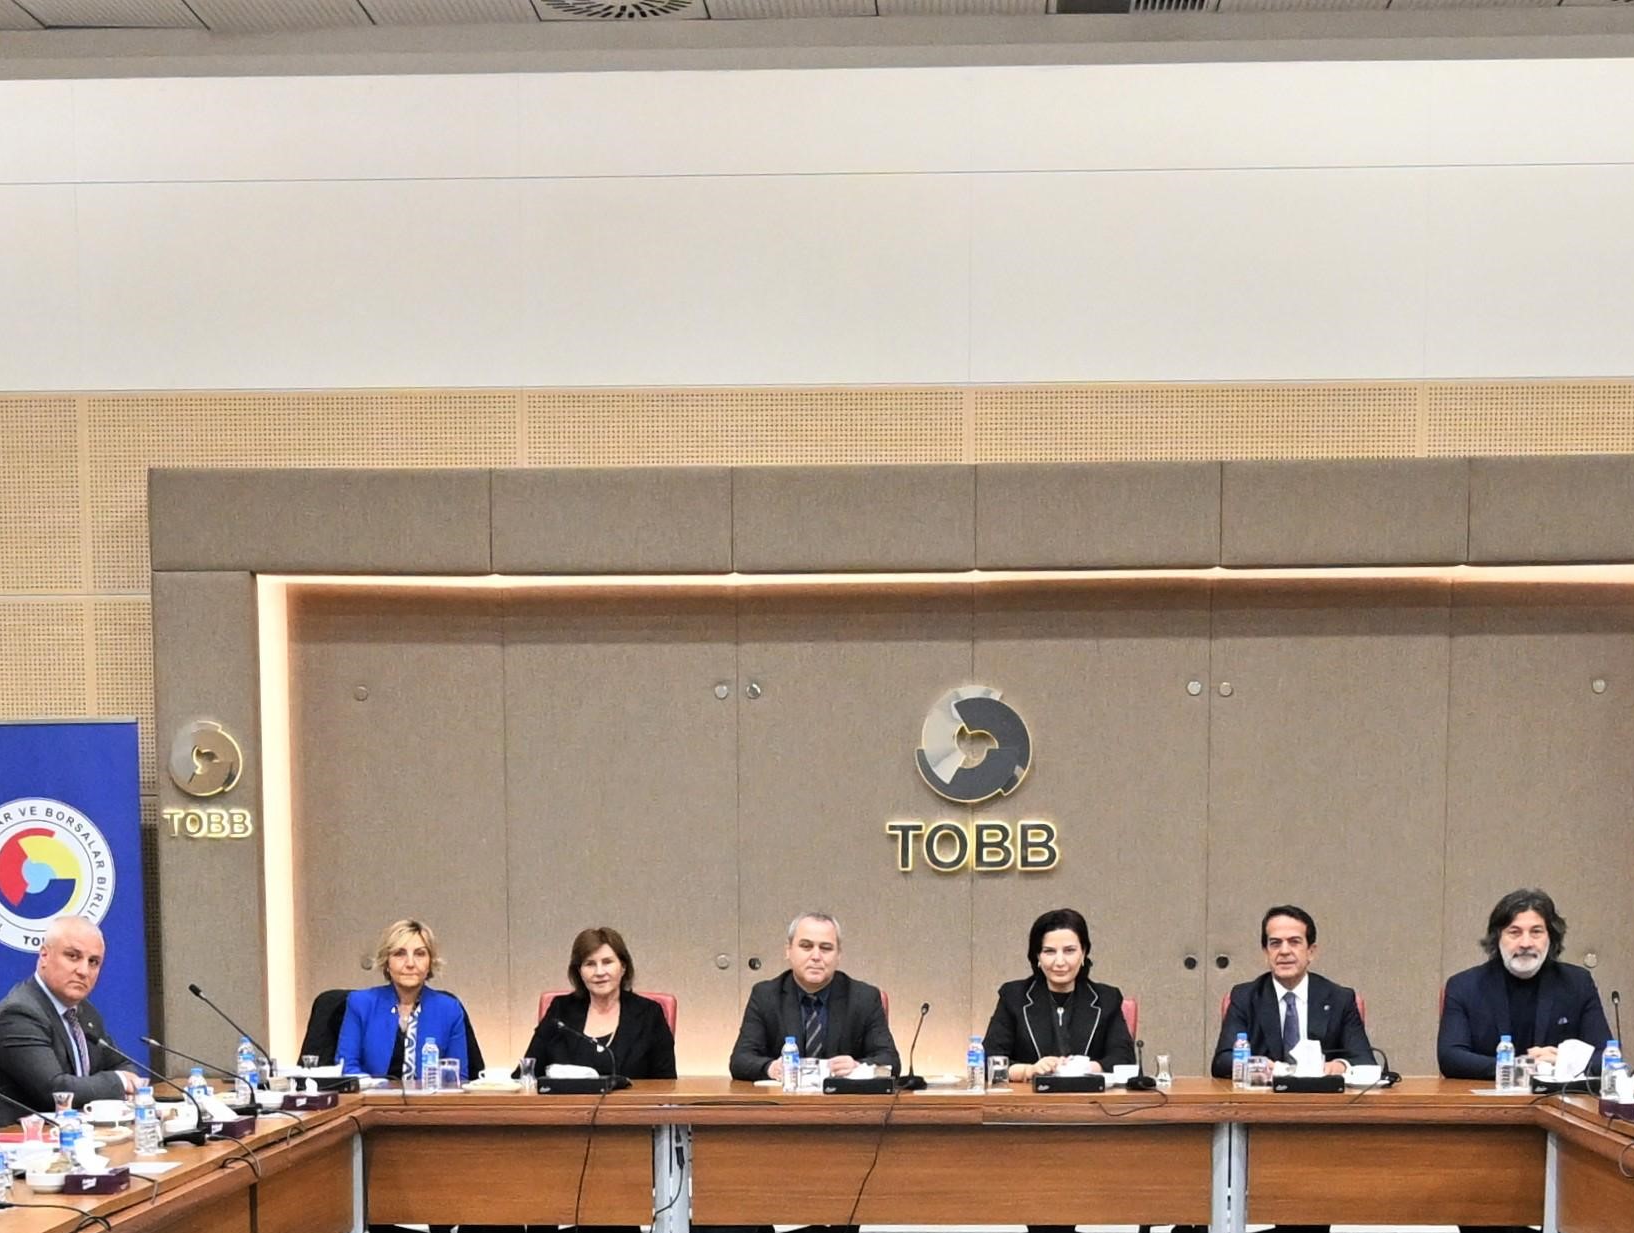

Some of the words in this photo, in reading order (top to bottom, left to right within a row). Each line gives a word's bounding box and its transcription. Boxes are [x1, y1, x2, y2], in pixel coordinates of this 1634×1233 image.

[18, 806, 37, 817] VE
[45, 807, 106, 869] BORSALAR
[162, 807, 253, 838] TOBB
[886, 821, 1059, 871] TOBB
[23, 935, 45, 946] TO
